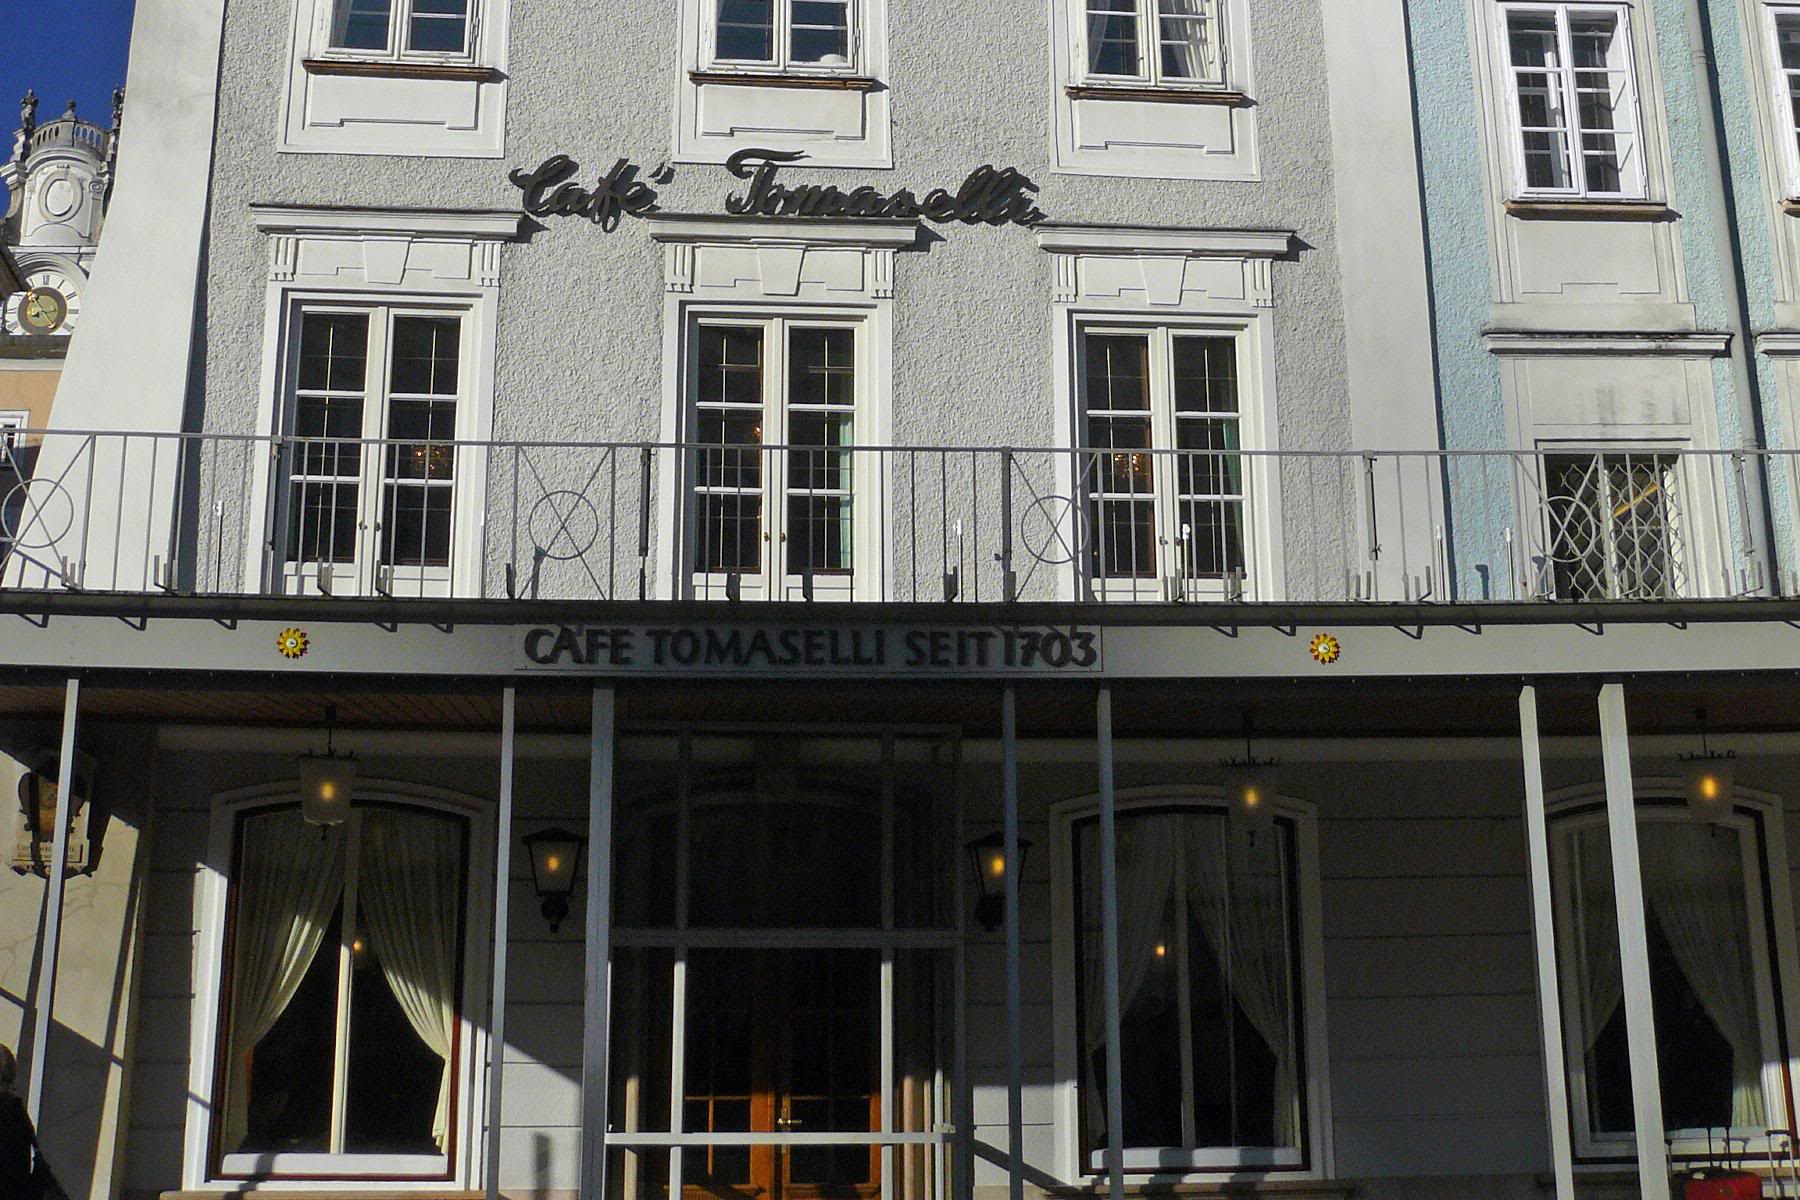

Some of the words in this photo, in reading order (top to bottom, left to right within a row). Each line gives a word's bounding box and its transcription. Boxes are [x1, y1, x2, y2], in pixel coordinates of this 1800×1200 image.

[725, 148, 1042, 227] Tomaselli
[646, 627, 885, 667] TOMASELLI
[904, 629, 995, 666] SEIT
[999, 627, 1098, 667] 1703
